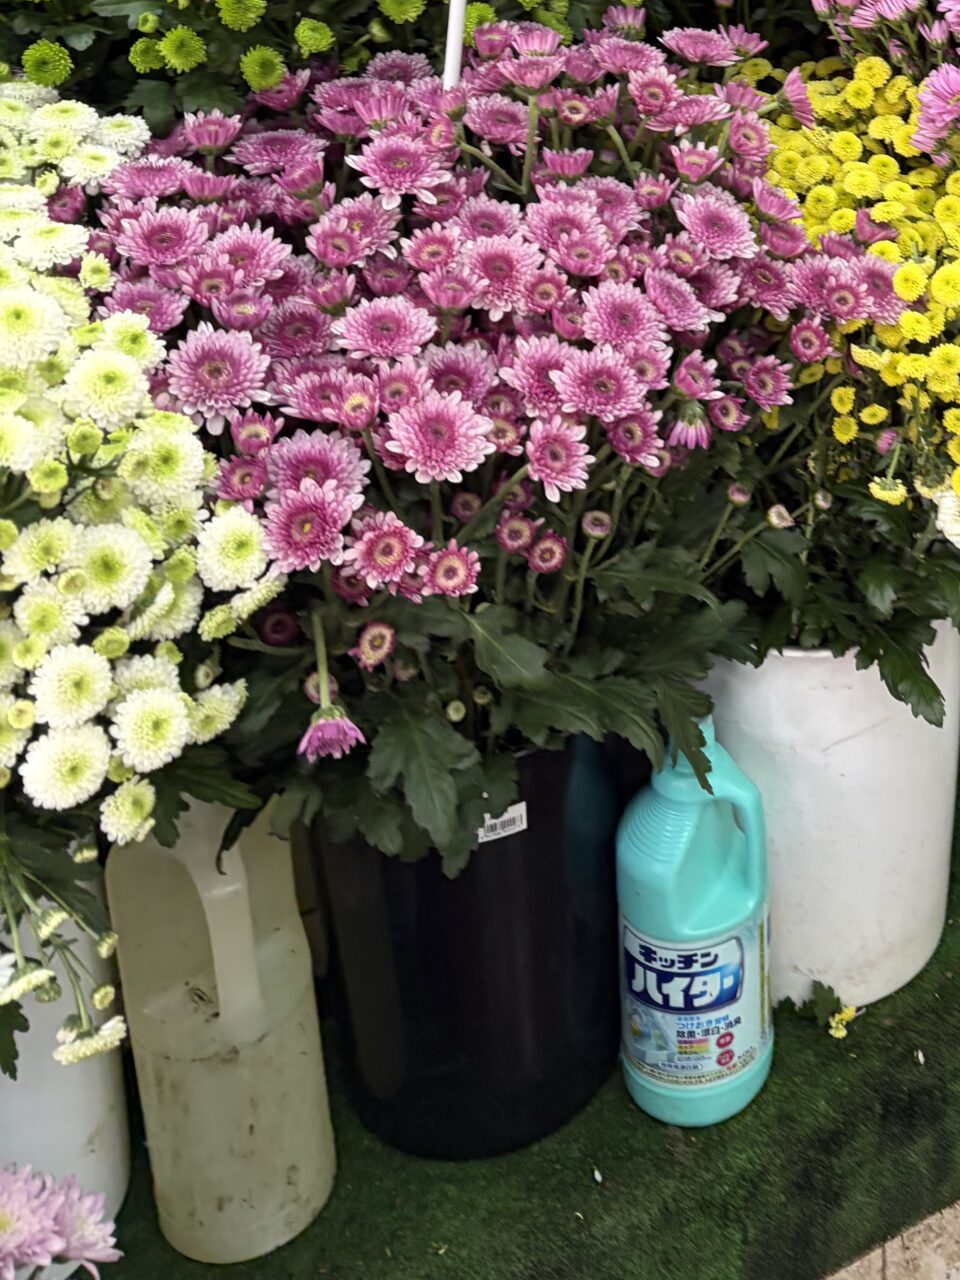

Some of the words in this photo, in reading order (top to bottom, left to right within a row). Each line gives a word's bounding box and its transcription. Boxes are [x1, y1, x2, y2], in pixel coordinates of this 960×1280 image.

[638, 943, 719, 971] キッチン
[631, 962, 735, 1009] ハイター
